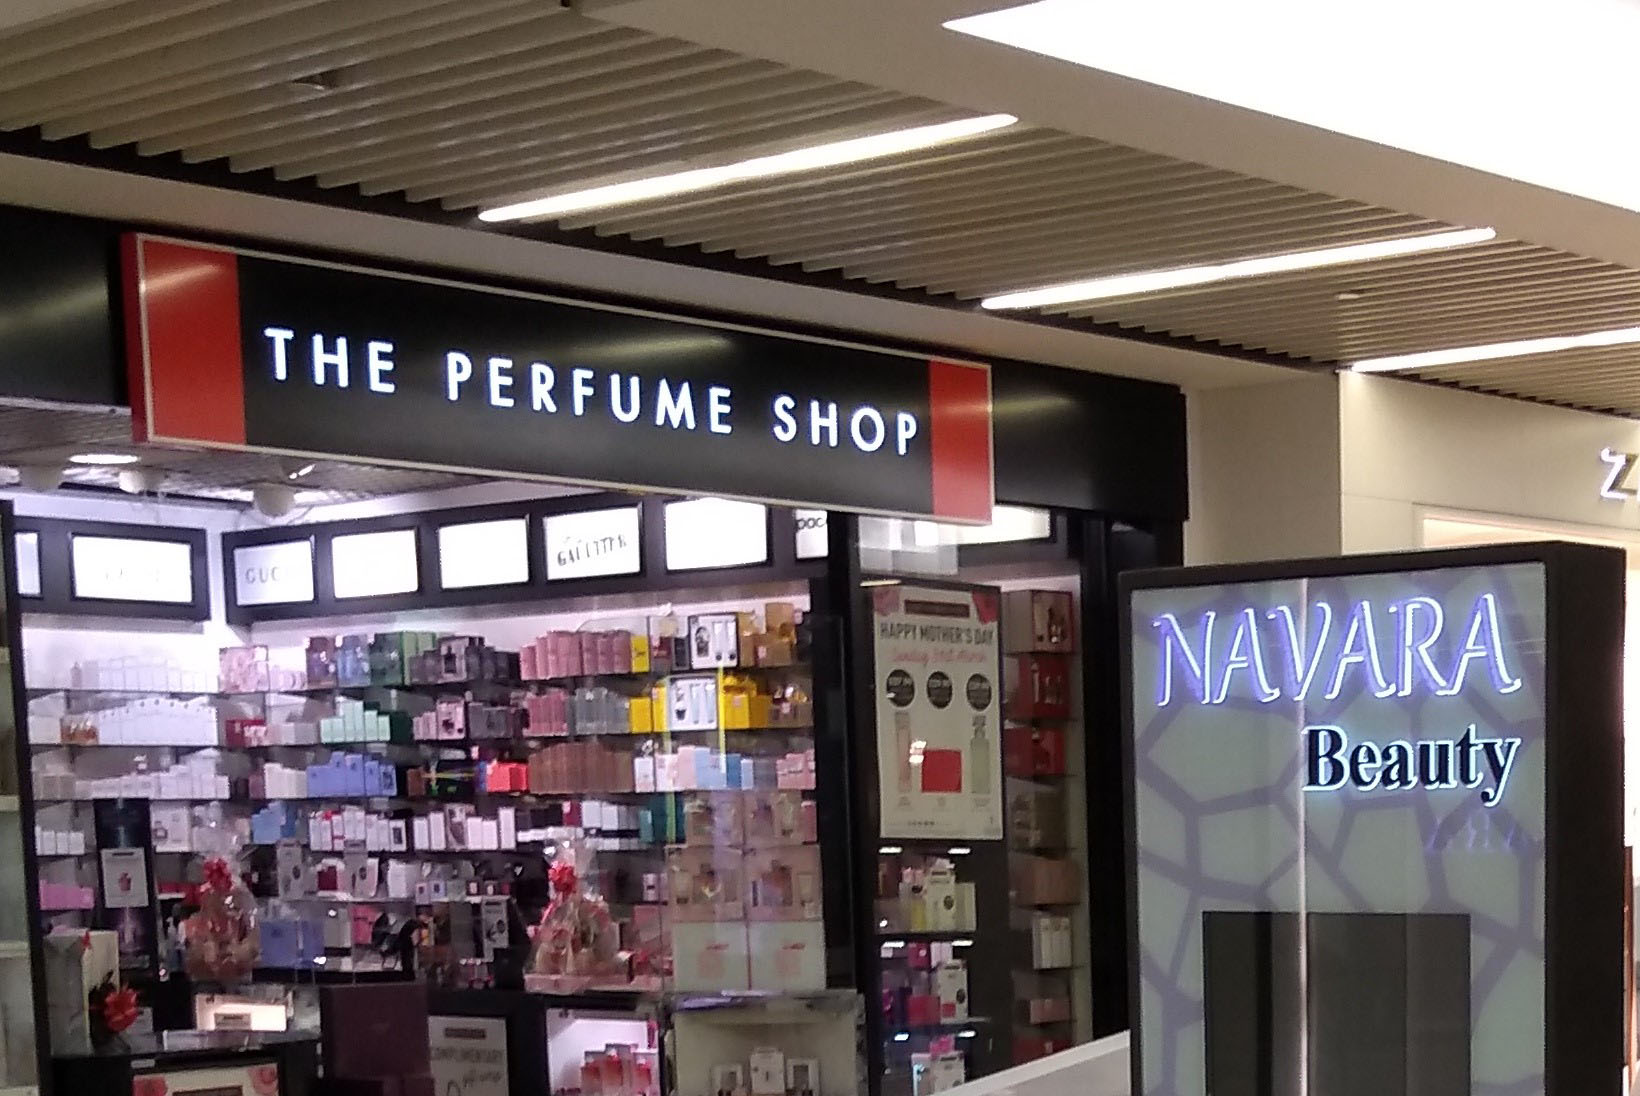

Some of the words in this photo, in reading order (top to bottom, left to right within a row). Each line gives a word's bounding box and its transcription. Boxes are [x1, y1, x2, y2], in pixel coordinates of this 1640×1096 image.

[264, 327, 395, 393] THE
[446, 351, 732, 435] PERFUME
[773, 395, 917, 455] SHOP
[1152, 593, 1522, 707] NAVARA
[1302, 723, 1521, 807] Beauty
